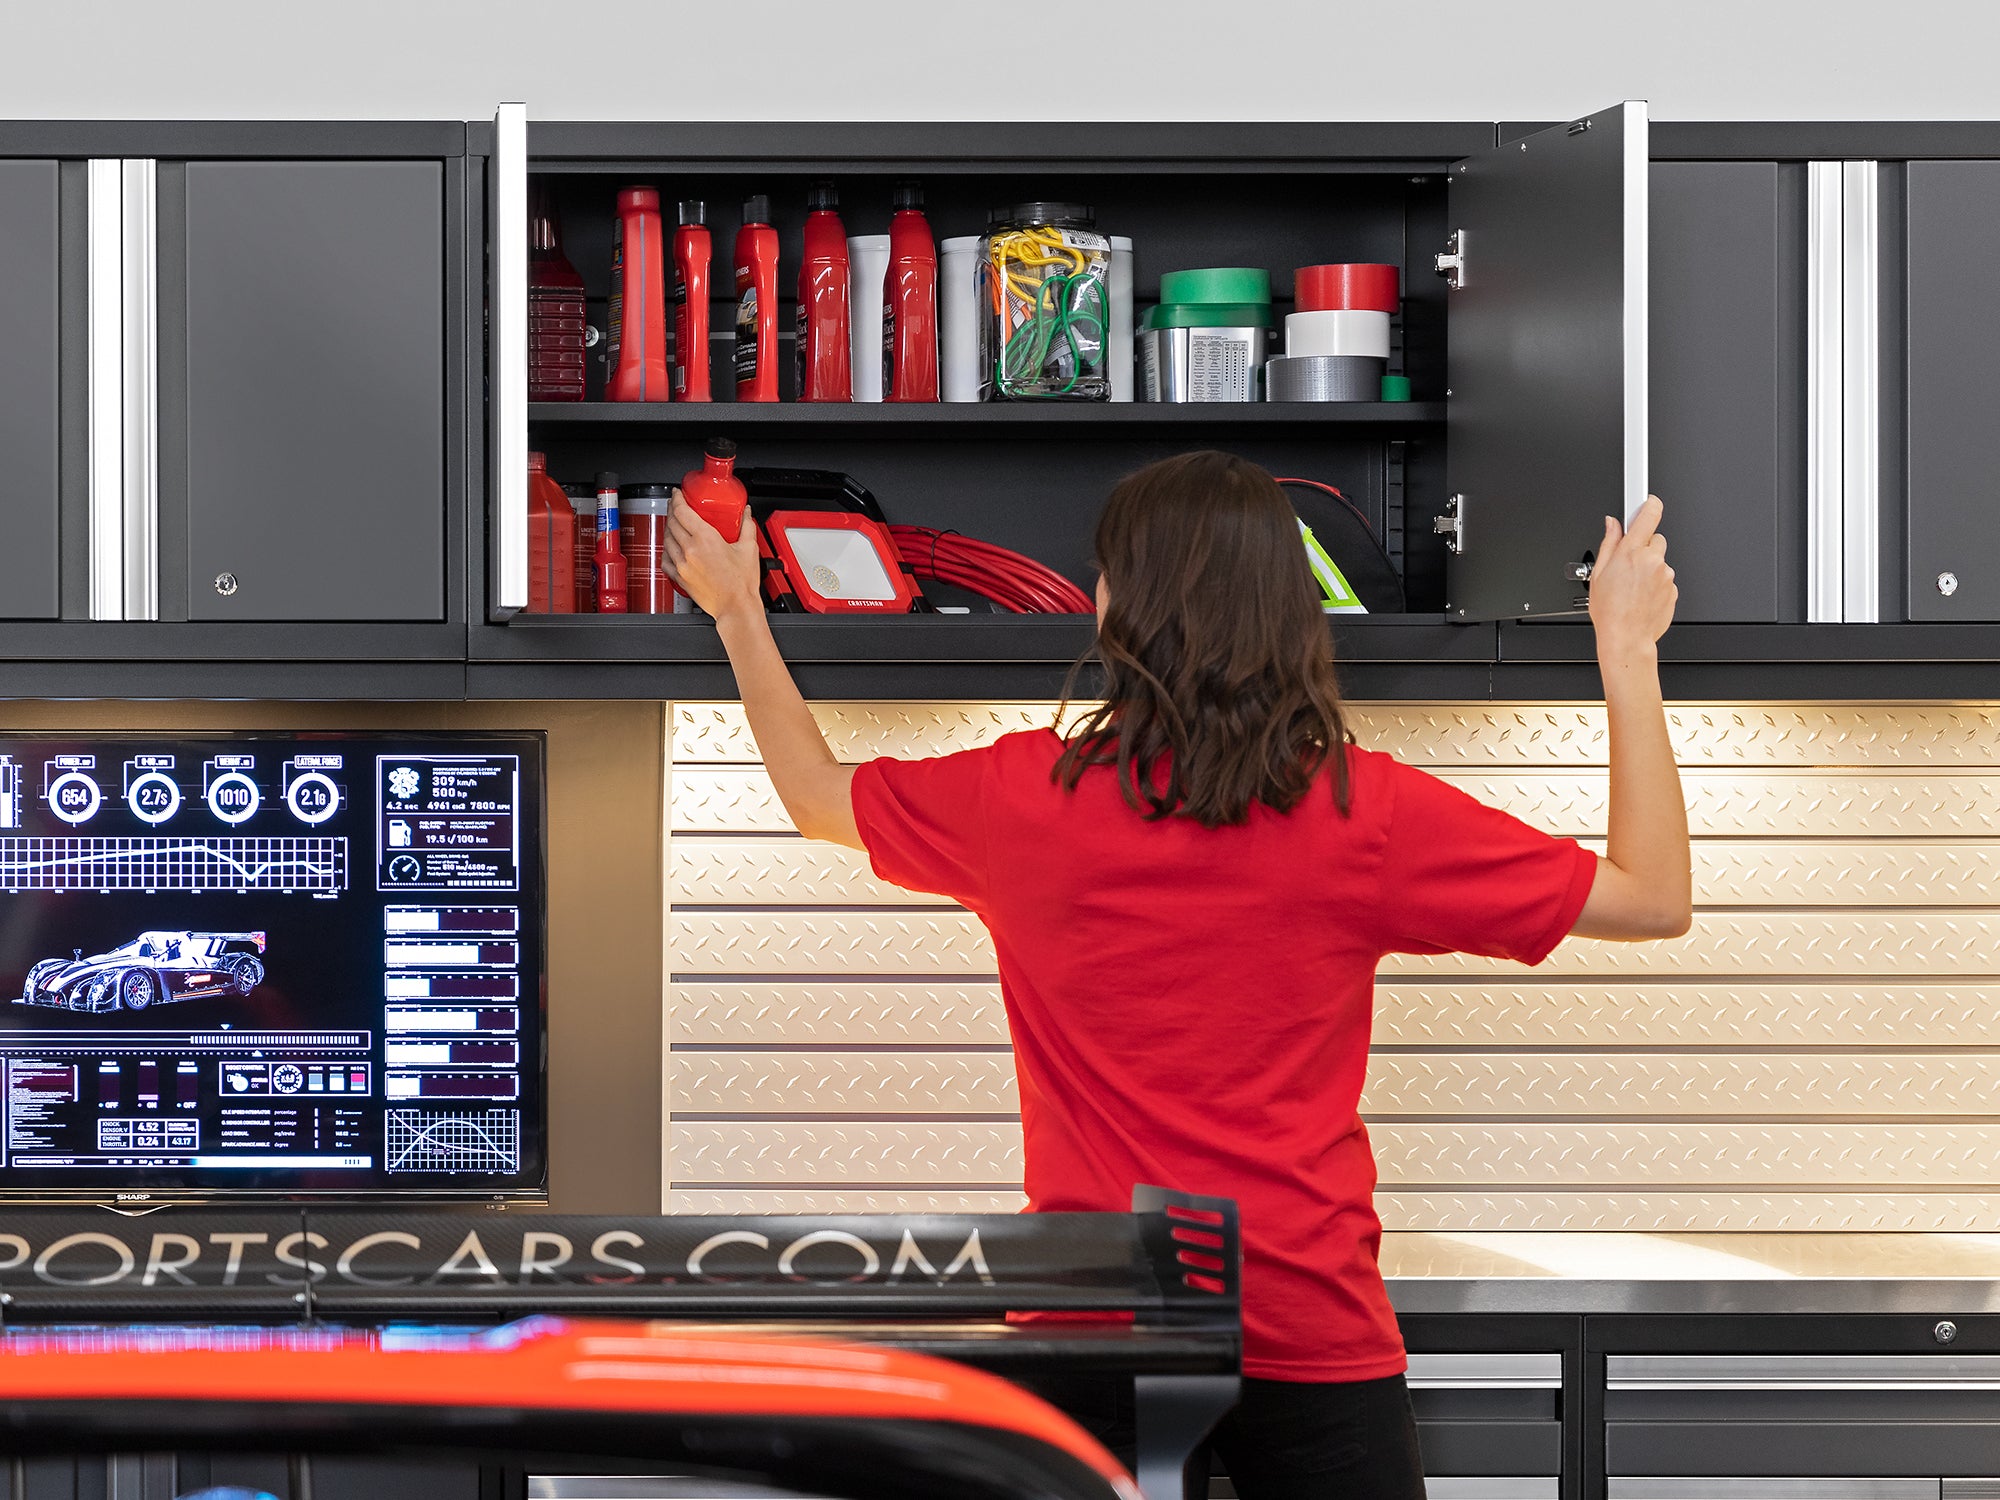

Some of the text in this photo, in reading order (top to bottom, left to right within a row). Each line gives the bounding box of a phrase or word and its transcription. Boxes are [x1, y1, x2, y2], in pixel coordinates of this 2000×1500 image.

[432, 776, 478, 787] 309 km/h
[61, 788, 88, 806] 654
[218, 788, 249, 806] 1010
[432, 787, 468, 799] 500 hp
[386, 801, 403, 811] 4.2
[427, 801, 450, 811] 4961
[469, 801, 496, 811] 7800
[425, 834, 446, 844] 19.5
[475, 835, 489, 844] km
[105, 1101, 119, 1109] OFF
[146, 1101, 158, 1109] ON
[183, 1101, 197, 1109] OFF
[137, 1122, 159, 1132] 4.52
[137, 1136, 159, 1146] 0.24
[171, 1137, 192, 1146] 43.17
